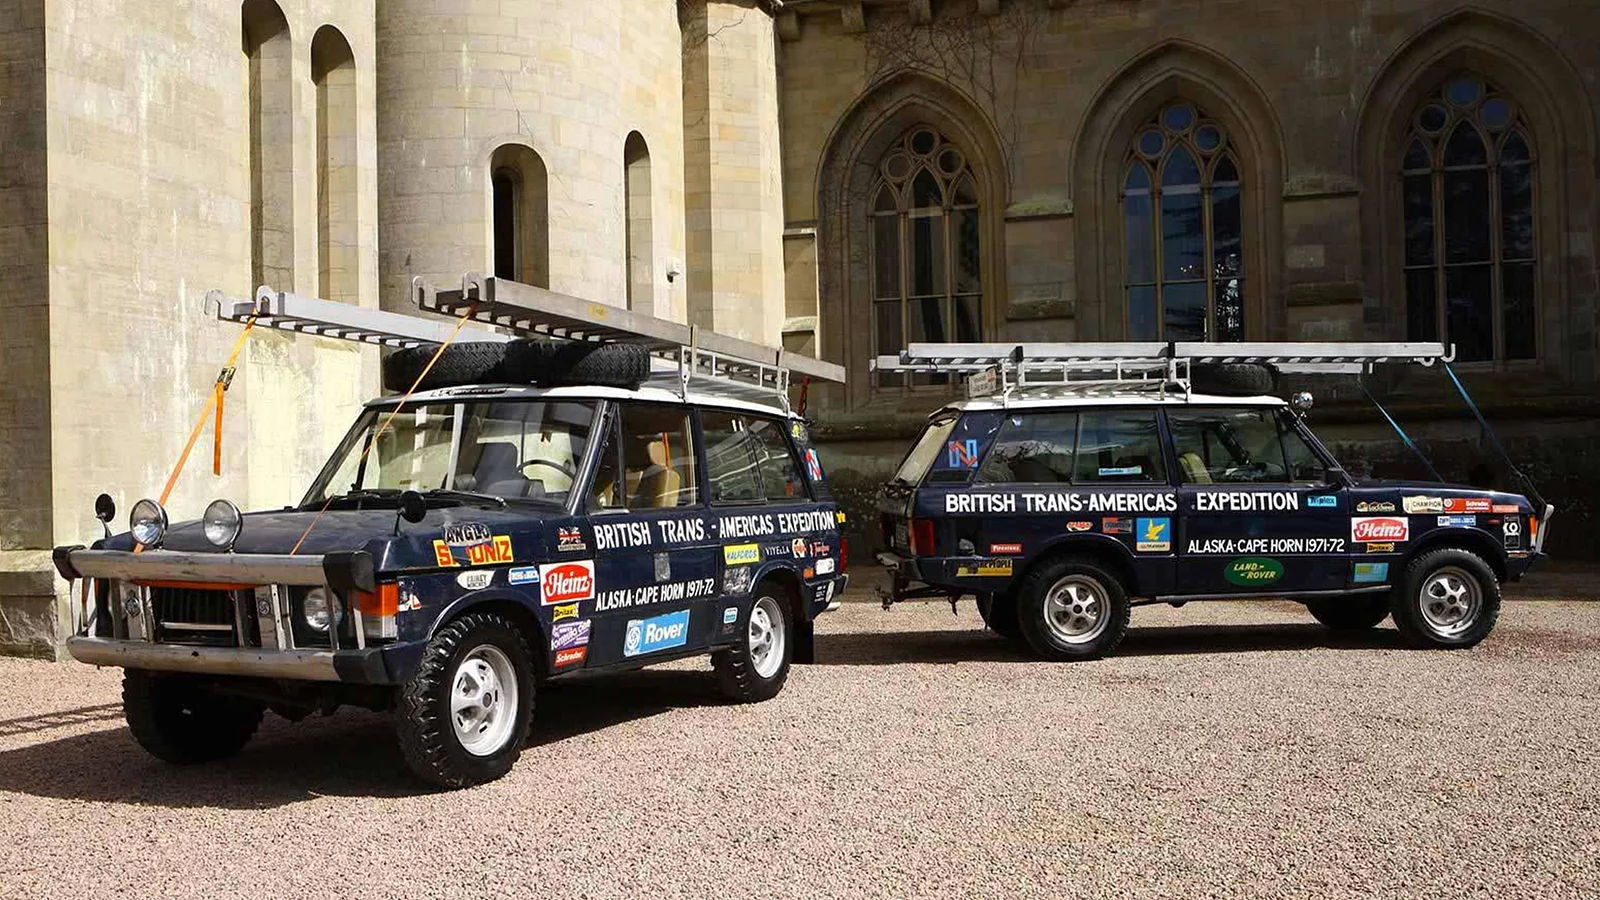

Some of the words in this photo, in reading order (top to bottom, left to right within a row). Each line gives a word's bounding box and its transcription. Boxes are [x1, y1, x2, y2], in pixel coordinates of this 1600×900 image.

[946, 493, 1016, 513] BRITISH
[1022, 493, 1178, 512] TRANS-AMERICAS
[1196, 492, 1299, 511] EXPEDITION
[593, 521, 652, 550] BRITISH
[777, 510, 836, 534] EXPEDITION
[1356, 522, 1404, 537] Heinz
[1270, 539, 1303, 553] HORN
[1306, 538, 1345, 552] 1971-72
[546, 572, 590, 597] Heinz
[661, 582, 684, 602] HORN
[686, 577, 714, 598] 1971-72
[644, 623, 684, 644] Rover
